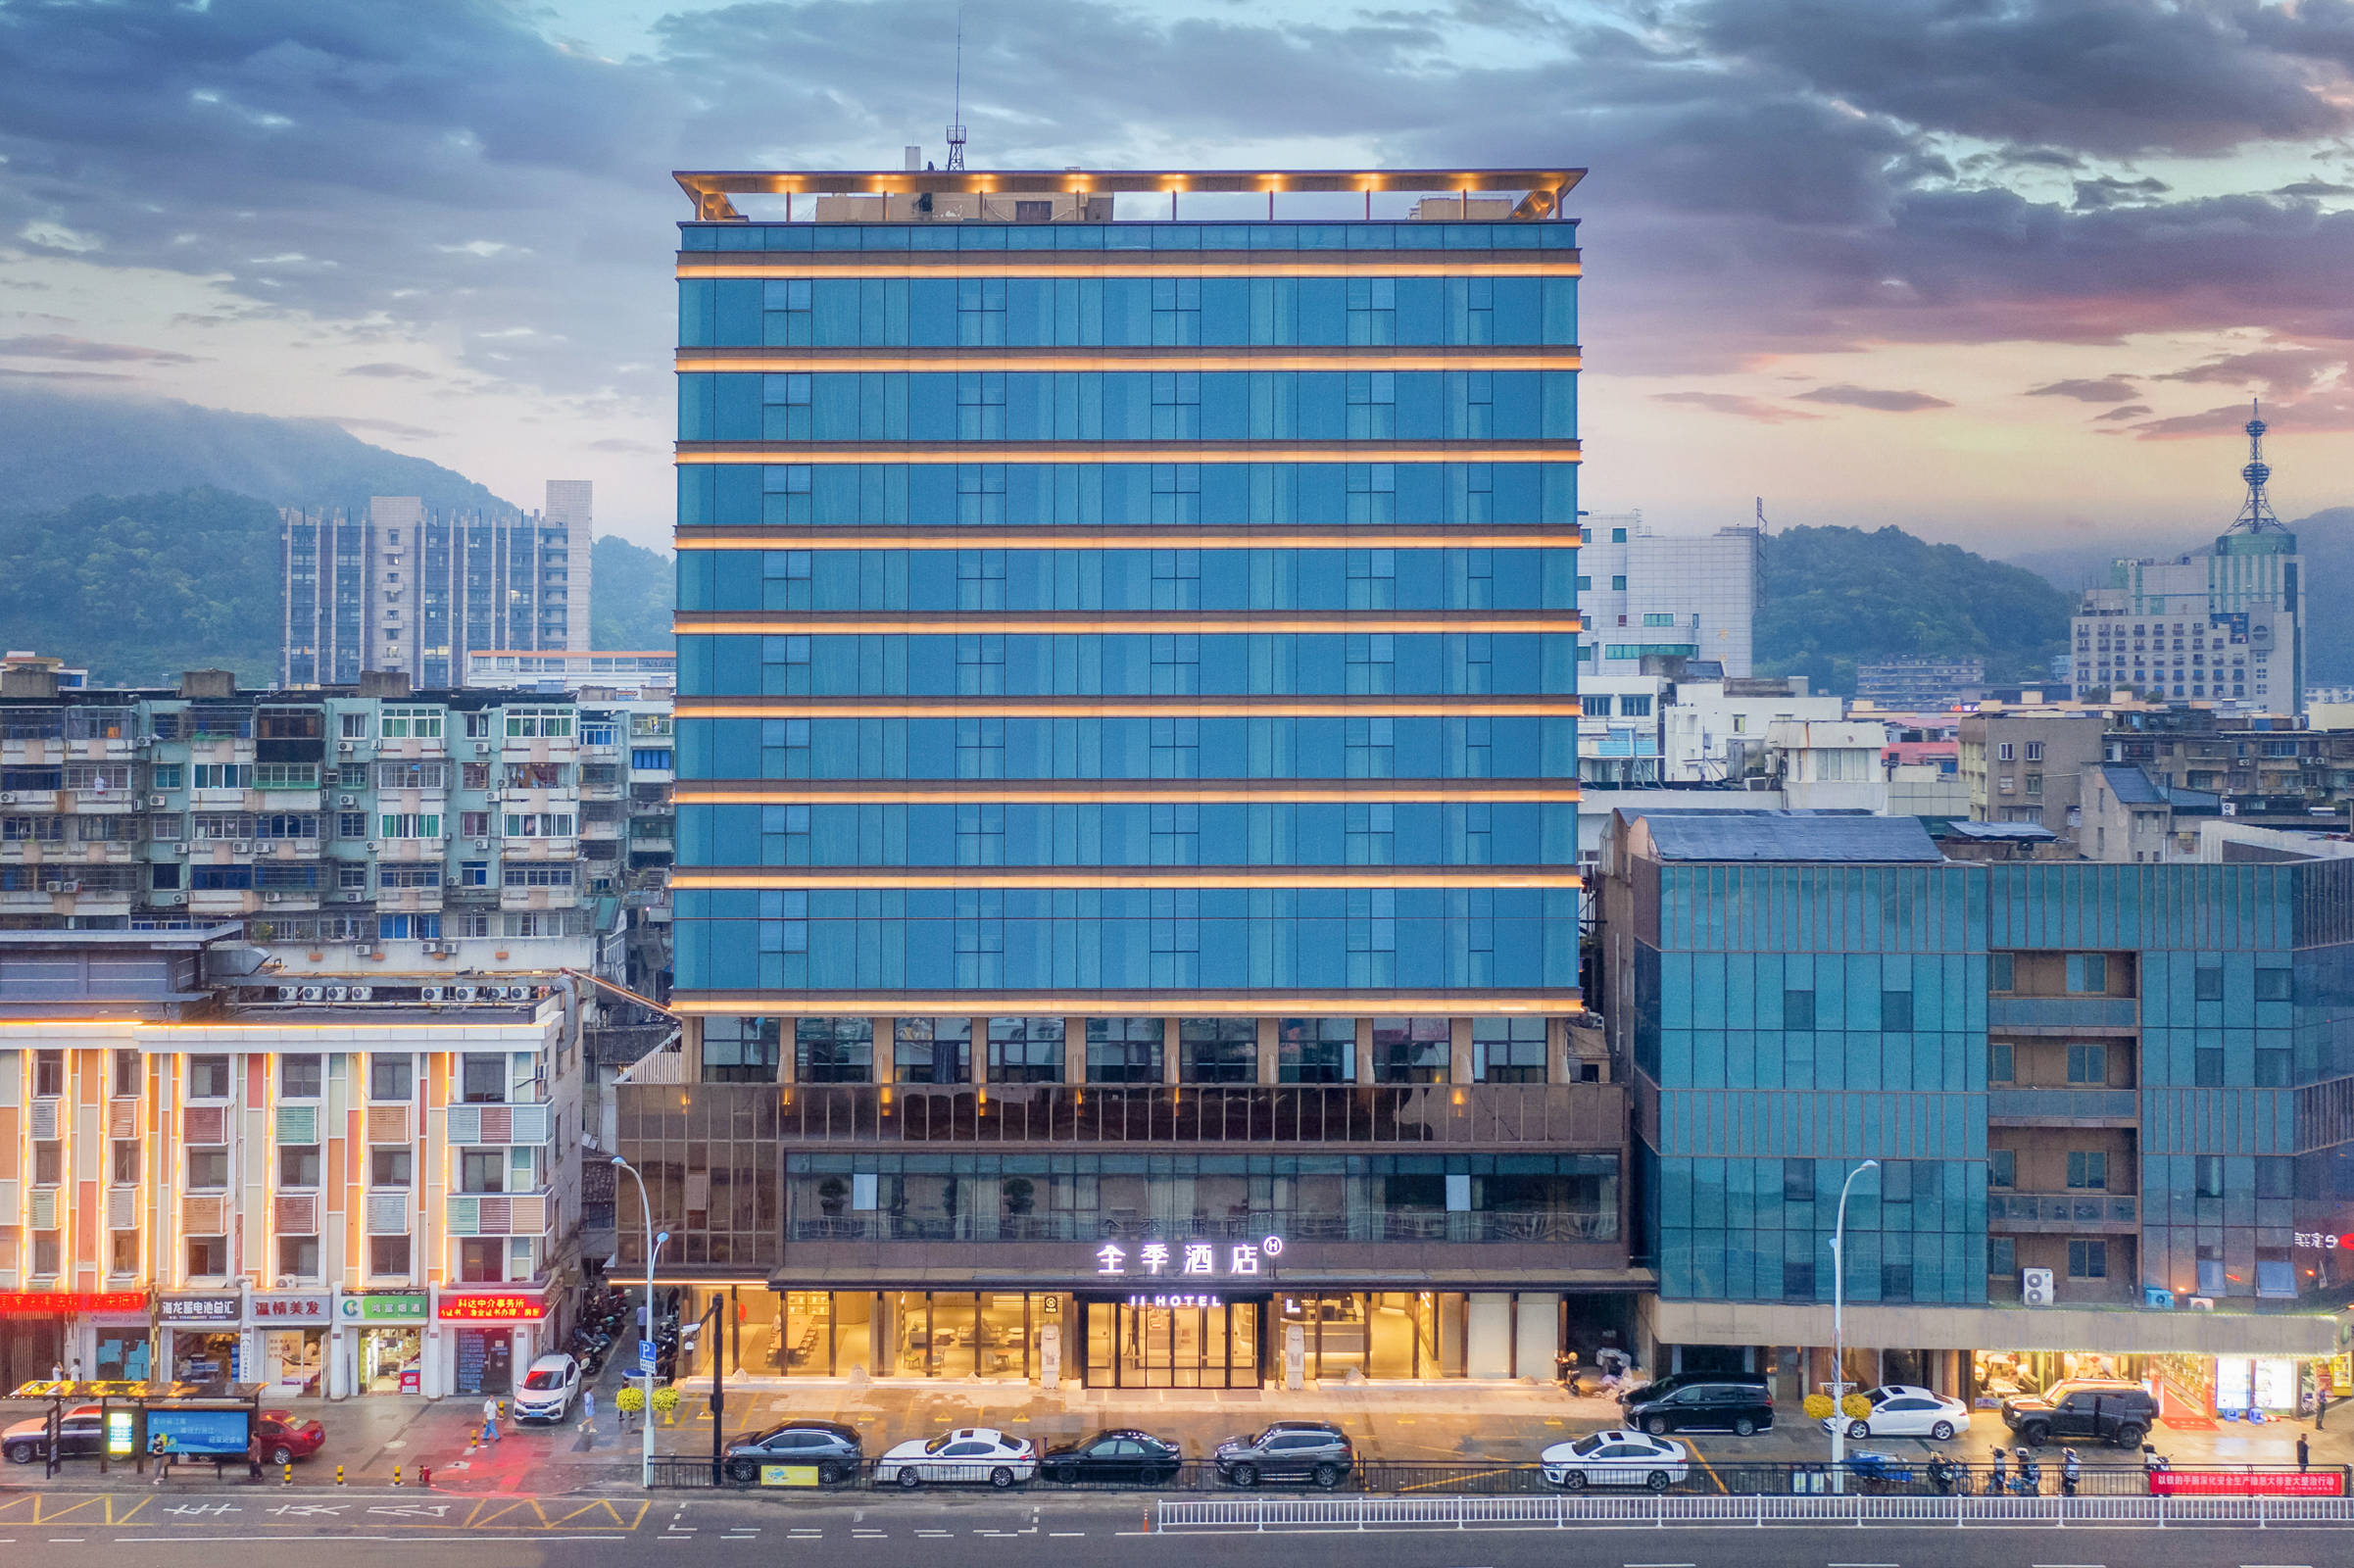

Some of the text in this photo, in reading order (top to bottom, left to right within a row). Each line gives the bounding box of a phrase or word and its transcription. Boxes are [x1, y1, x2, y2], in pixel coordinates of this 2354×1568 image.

[1097, 1244, 1258, 1274] 全季酒店
[255, 1300, 320, 1316] 温情美发
[458, 1298, 525, 1308] 科达中介事务所
[1130, 1295, 1221, 1307] JI HOTEL
[642, 1344, 650, 1358] P
